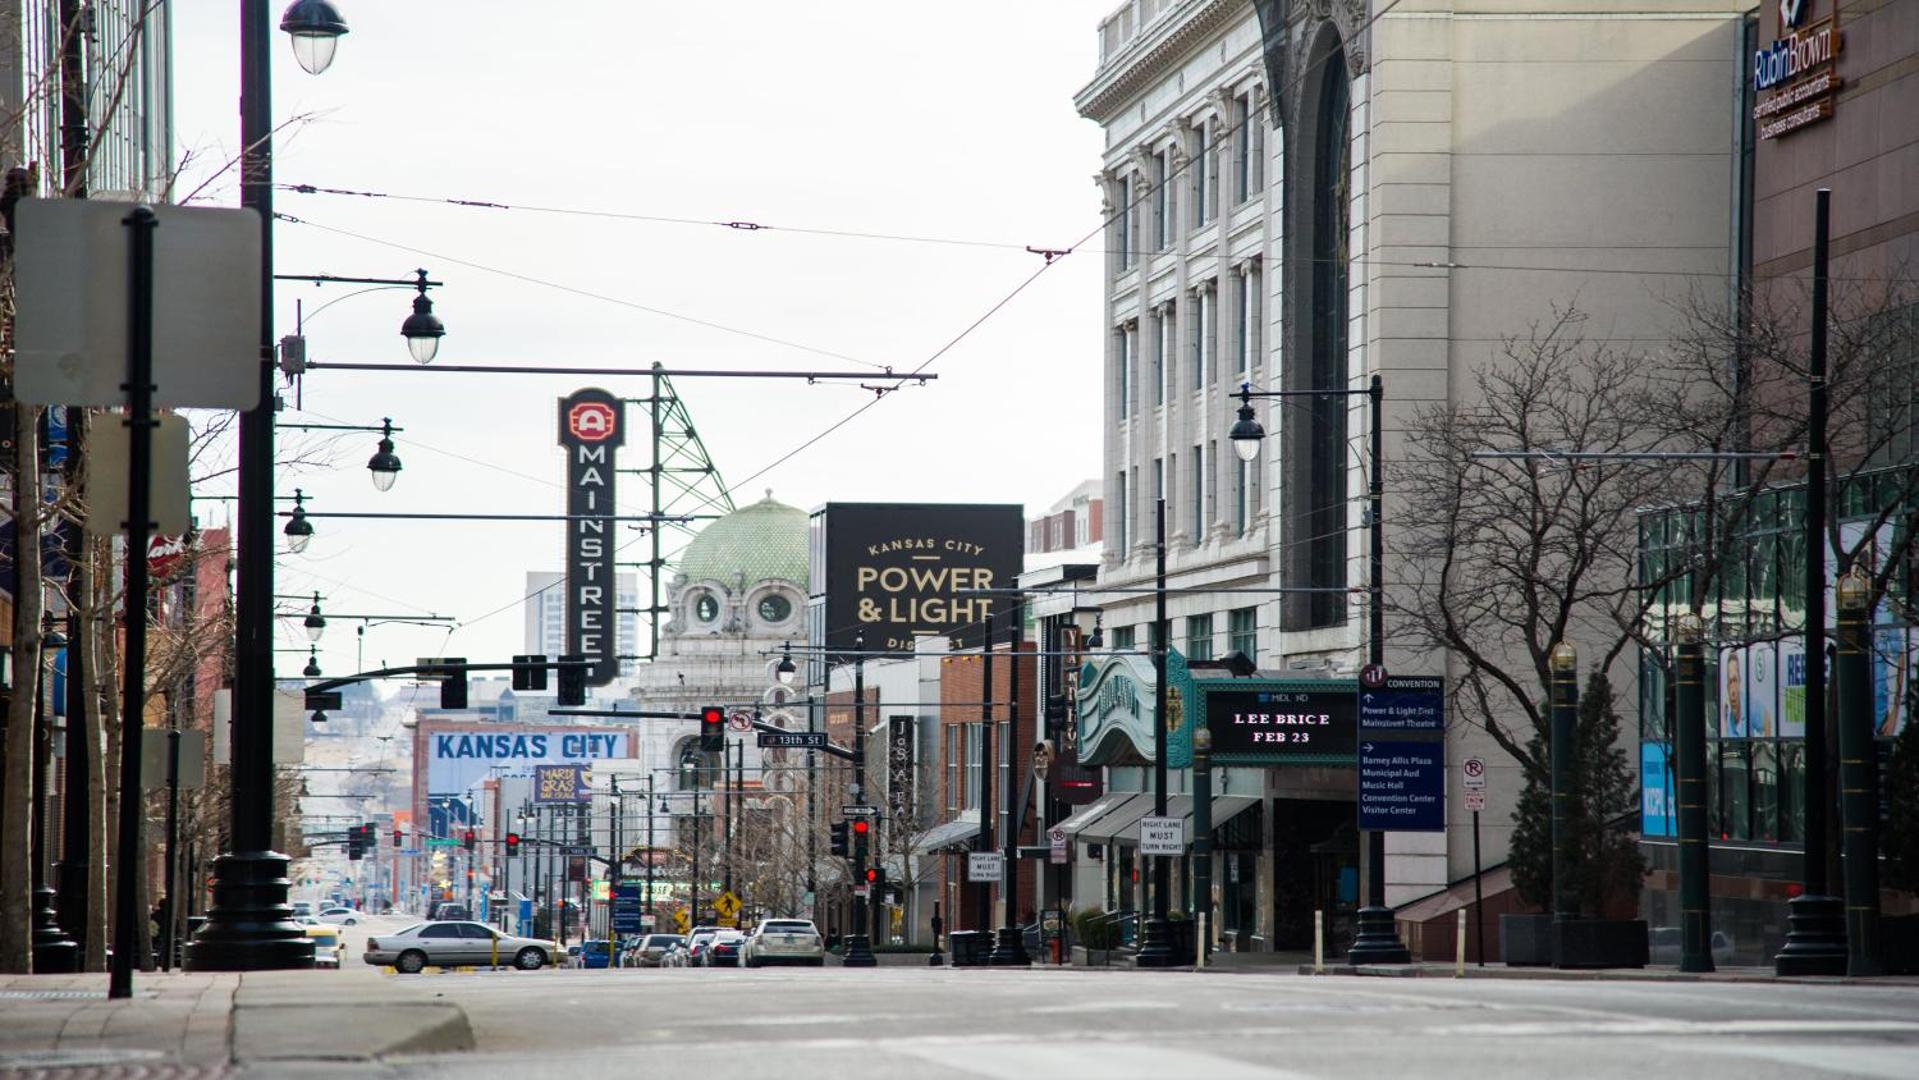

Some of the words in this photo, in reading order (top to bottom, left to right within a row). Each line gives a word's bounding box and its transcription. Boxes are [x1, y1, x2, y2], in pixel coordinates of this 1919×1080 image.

[1754, 29, 1831, 91] RubinBrown
[868, 539, 935, 556] KANSAS
[944, 540, 984, 556] CITY
[858, 567, 994, 592] POWER
[858, 598, 882, 622] &
[890, 598, 993, 623] LIGHT
[1387, 679, 1440, 688] CONVENTION
[1362, 706, 1386, 715] Power
[1388, 706, 1395, 715] &
[1396, 706, 1416, 717] Light
[1234, 714, 1270, 724] LEE
[1276, 714, 1330, 725] BRICE
[780, 736, 803, 745] 13th
[807, 736, 819, 745] St
[1253, 732, 1286, 742] FEB
[1292, 732, 1310, 743] 23
[437, 734, 547, 759] KANSAS
[562, 734, 618, 759] CITY
[1362, 756, 1390, 766] Barney
[1411, 756, 1432, 765] Plaza
[1362, 769, 1402, 779] Municipal
[1404, 769, 1420, 777] Aud
[1362, 781, 1385, 789] Music
[1387, 781, 1404, 789] Hall
[1362, 794, 1408, 802] Convention
[1409, 794, 1436, 803] Center
[1362, 806, 1389, 814] Visitor
[1390, 806, 1417, 815] Center
[1163, 820, 1182, 828] LANE
[1150, 832, 1174, 840] MUST
